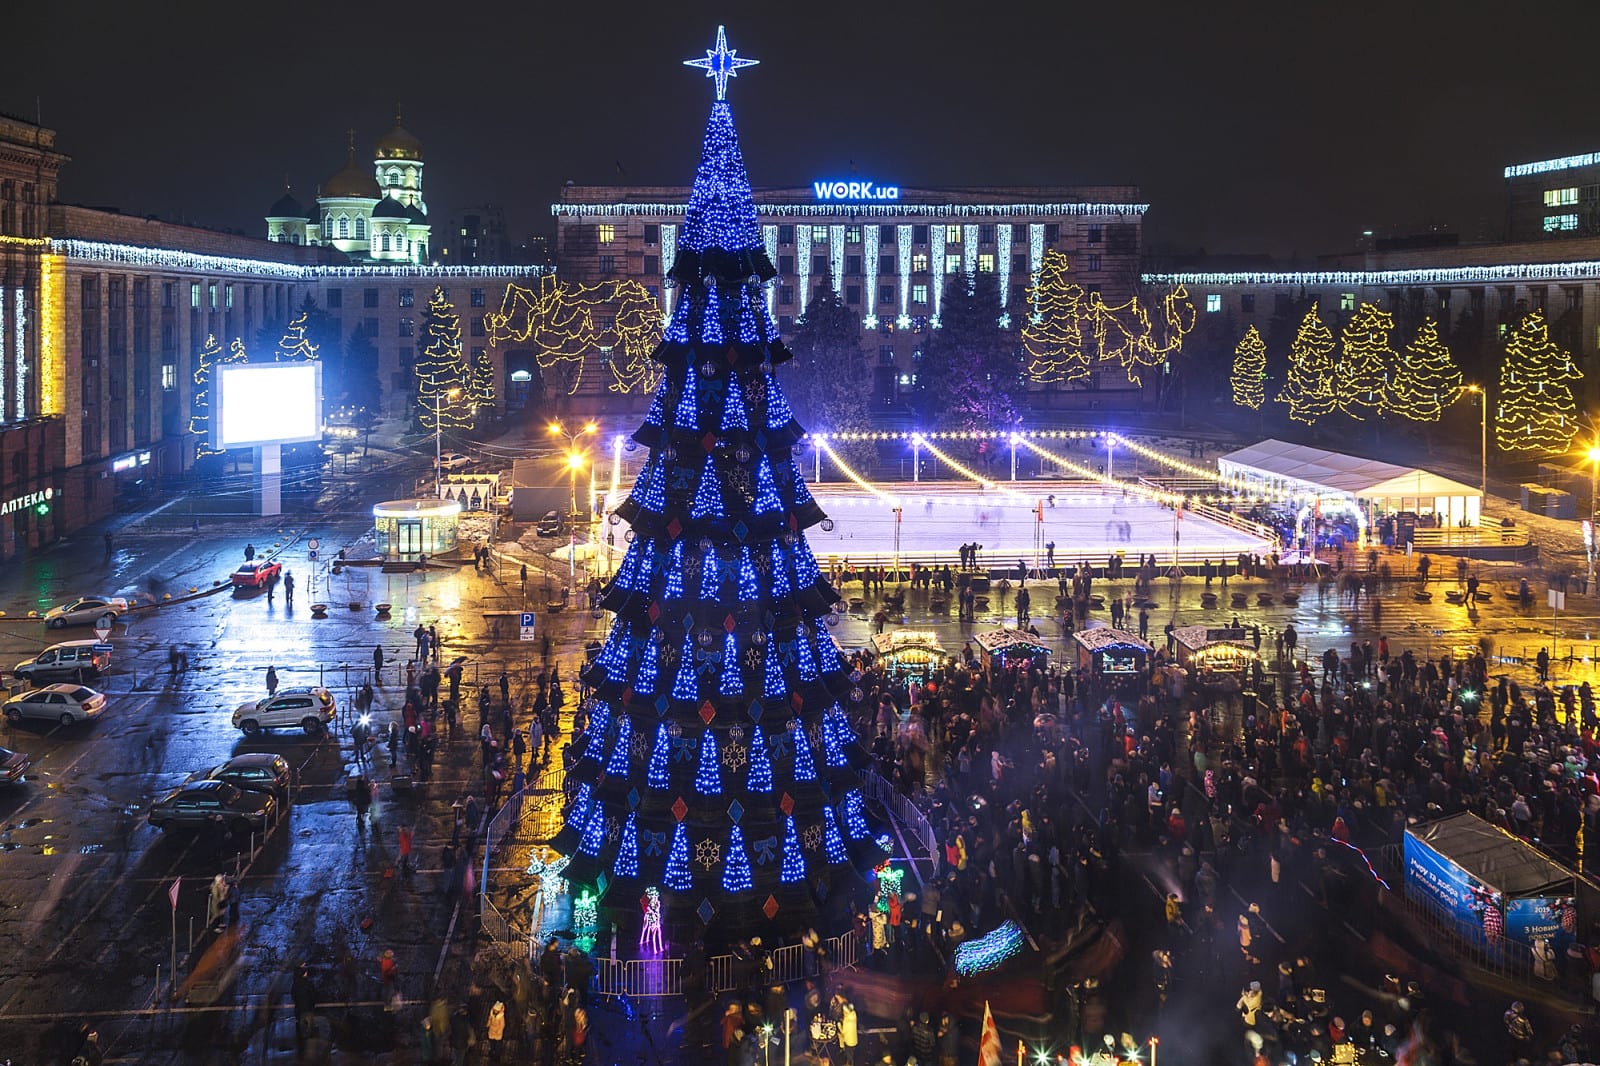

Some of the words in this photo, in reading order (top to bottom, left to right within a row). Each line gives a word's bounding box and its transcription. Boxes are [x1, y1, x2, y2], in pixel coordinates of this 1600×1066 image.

[814, 182, 898, 199] WORK.ua
[1, 490, 45, 515] АПТЕКА
[523, 614, 531, 625] P
[1531, 924, 1559, 933] Новим
